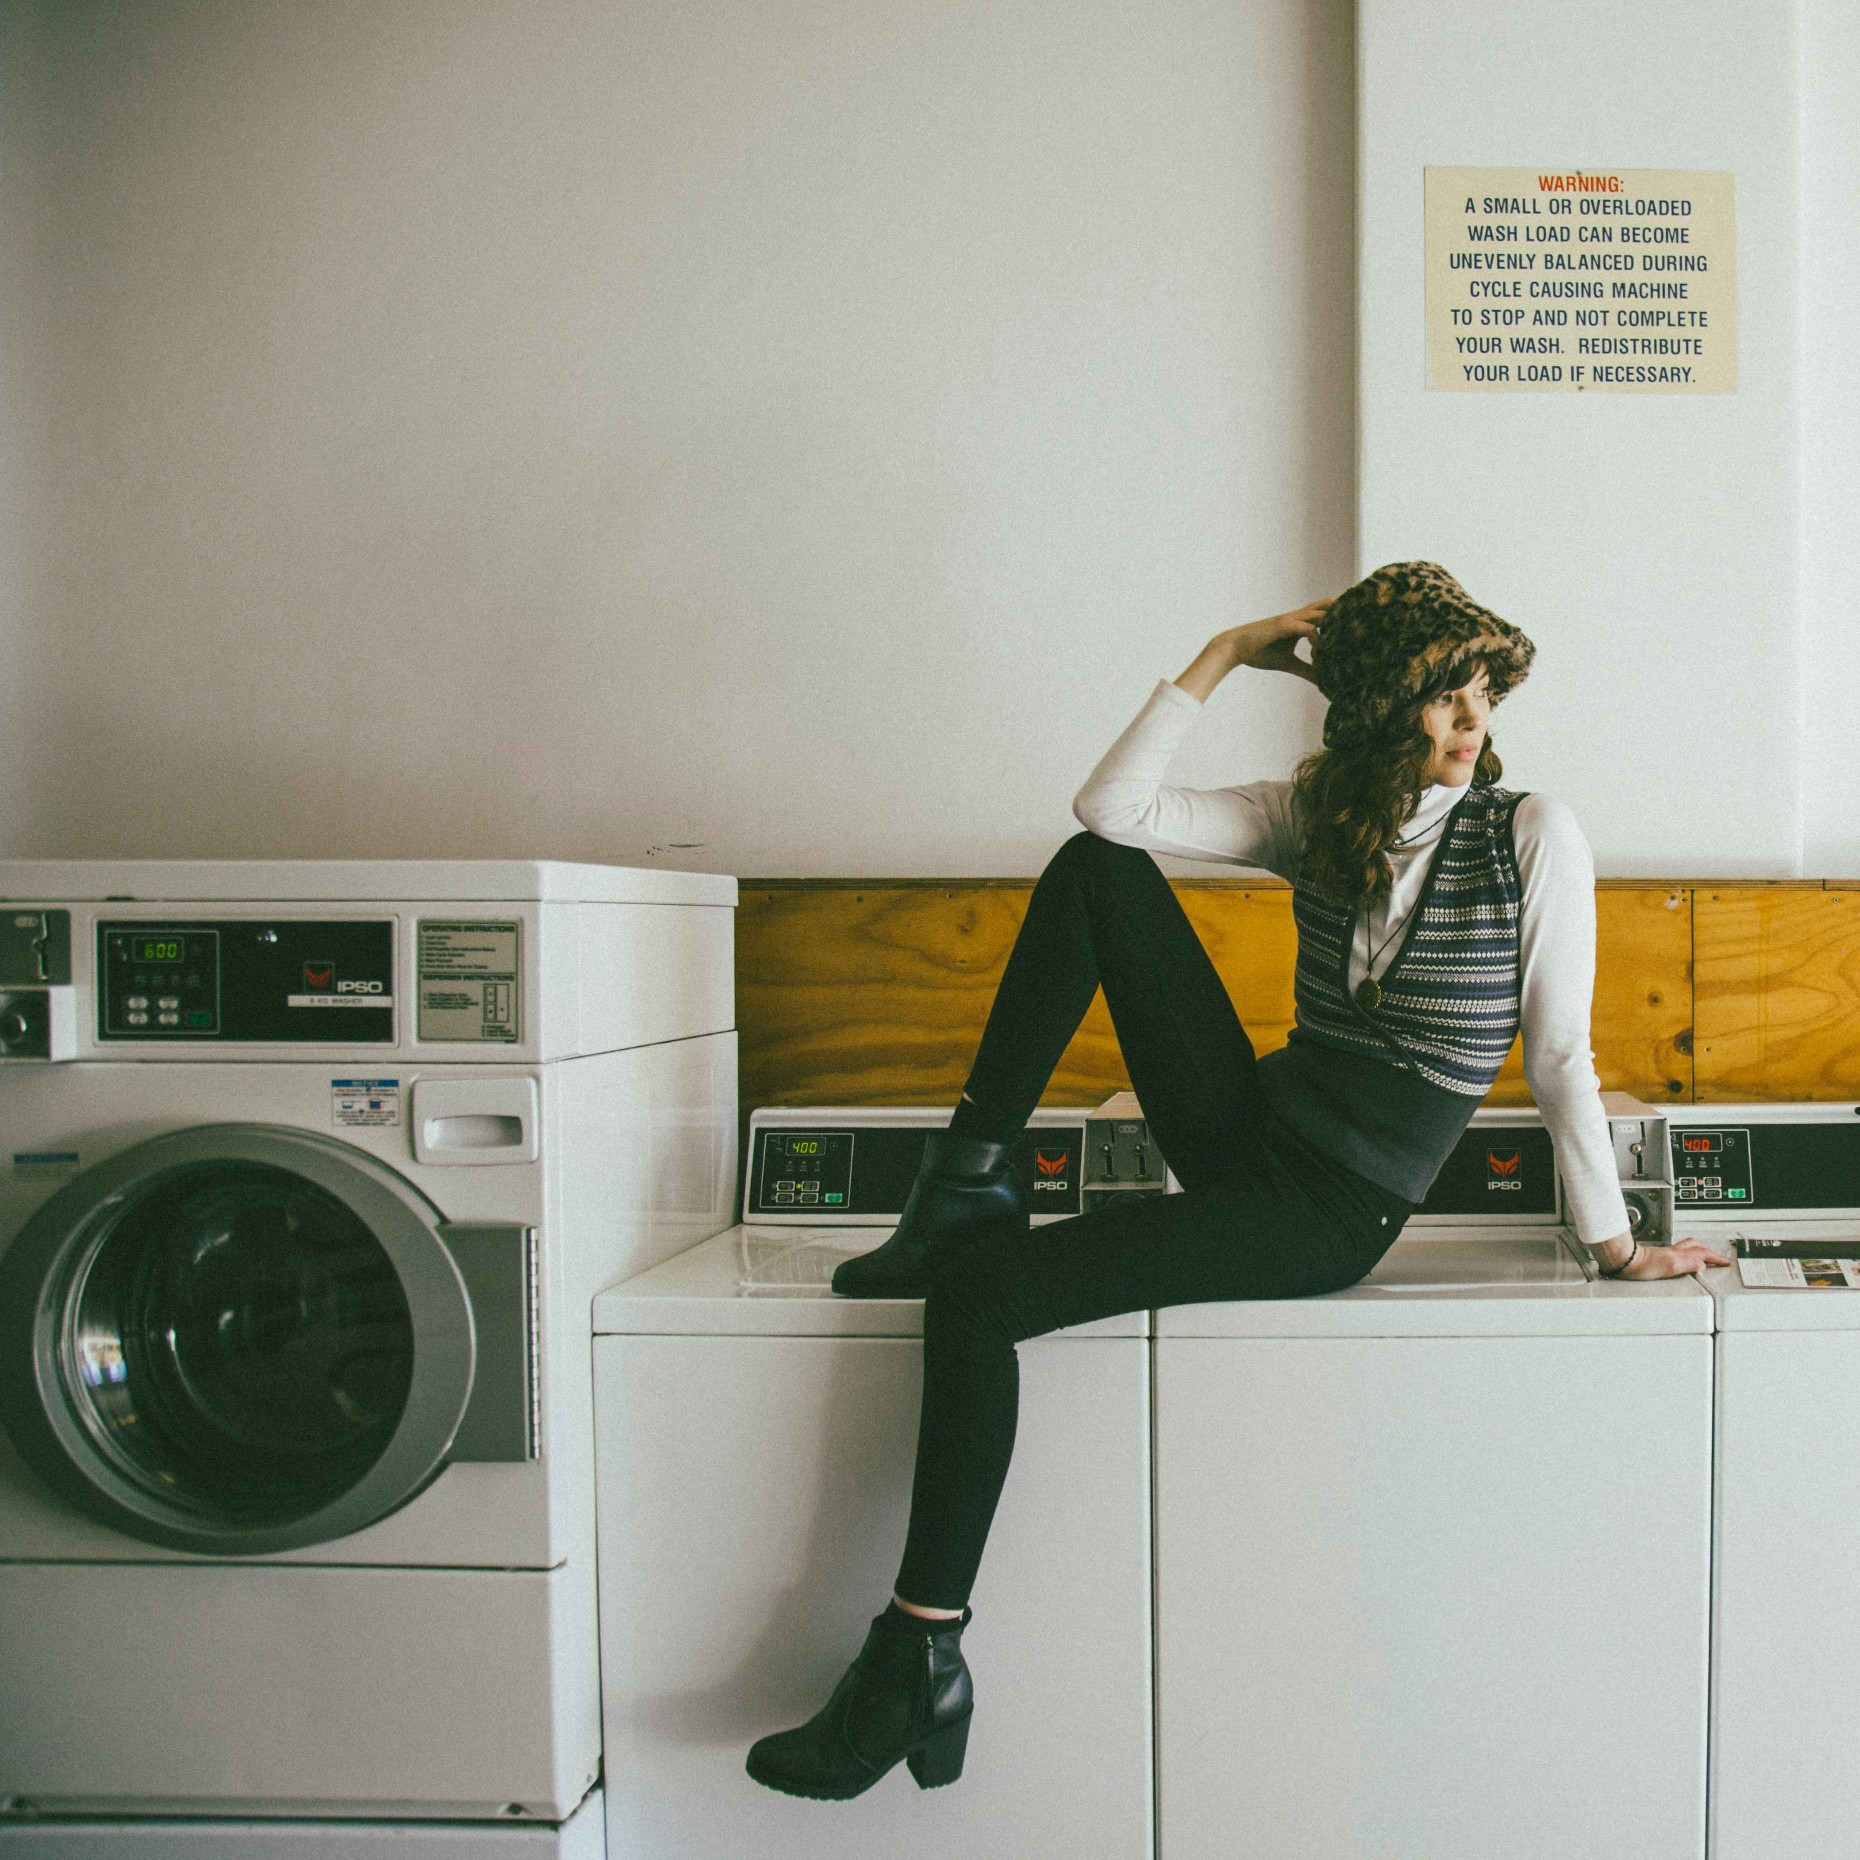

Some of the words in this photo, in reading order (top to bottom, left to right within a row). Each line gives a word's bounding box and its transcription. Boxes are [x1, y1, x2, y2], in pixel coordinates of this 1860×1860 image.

[1538, 175, 1624, 193] WARNING:
[1465, 198, 1475, 213] A
[1484, 198, 1541, 214] SMALL
[1549, 199, 1571, 214] OR
[1580, 199, 1691, 216] OVERLOADED
[1468, 226, 1517, 241] WASH
[1526, 226, 1570, 242] LOAD
[1579, 227, 1612, 242] CAN
[1621, 227, 1689, 243] BECOME
[1450, 253, 1536, 269] UNEVENLY
[1545, 254, 1634, 270] BALANCED
[1643, 255, 1707, 271] DURING
[1470, 281, 1521, 297] CYCLE
[1530, 282, 1603, 298] CAUSING
[1613, 283, 1688, 299] MACHINE
[1451, 309, 1472, 325] TO
[1481, 309, 1524, 325] STOP
[1533, 310, 1567, 325] AND
[1576, 310, 1609, 326] NOT
[1618, 310, 1707, 327] COMPLETE
[1456, 337, 1501, 353] YOUR
[1510, 338, 1564, 353] WASH.
[1579, 338, 1702, 355] REDISTRIBUTE
[1463, 365, 1509, 381] YOUR
[1518, 365, 1562, 381] LOAD
[1571, 366, 1584, 381] IF
[1593, 366, 1695, 382] NECESSARY.
[145, 944, 177, 959] 600
[337, 981, 383, 993] IPSO
[793, 1142, 818, 1154] 400
[1684, 1139, 1710, 1152] 400
[1033, 1181, 1068, 1191] IPSO
[1487, 1181, 1522, 1191] IPSO
